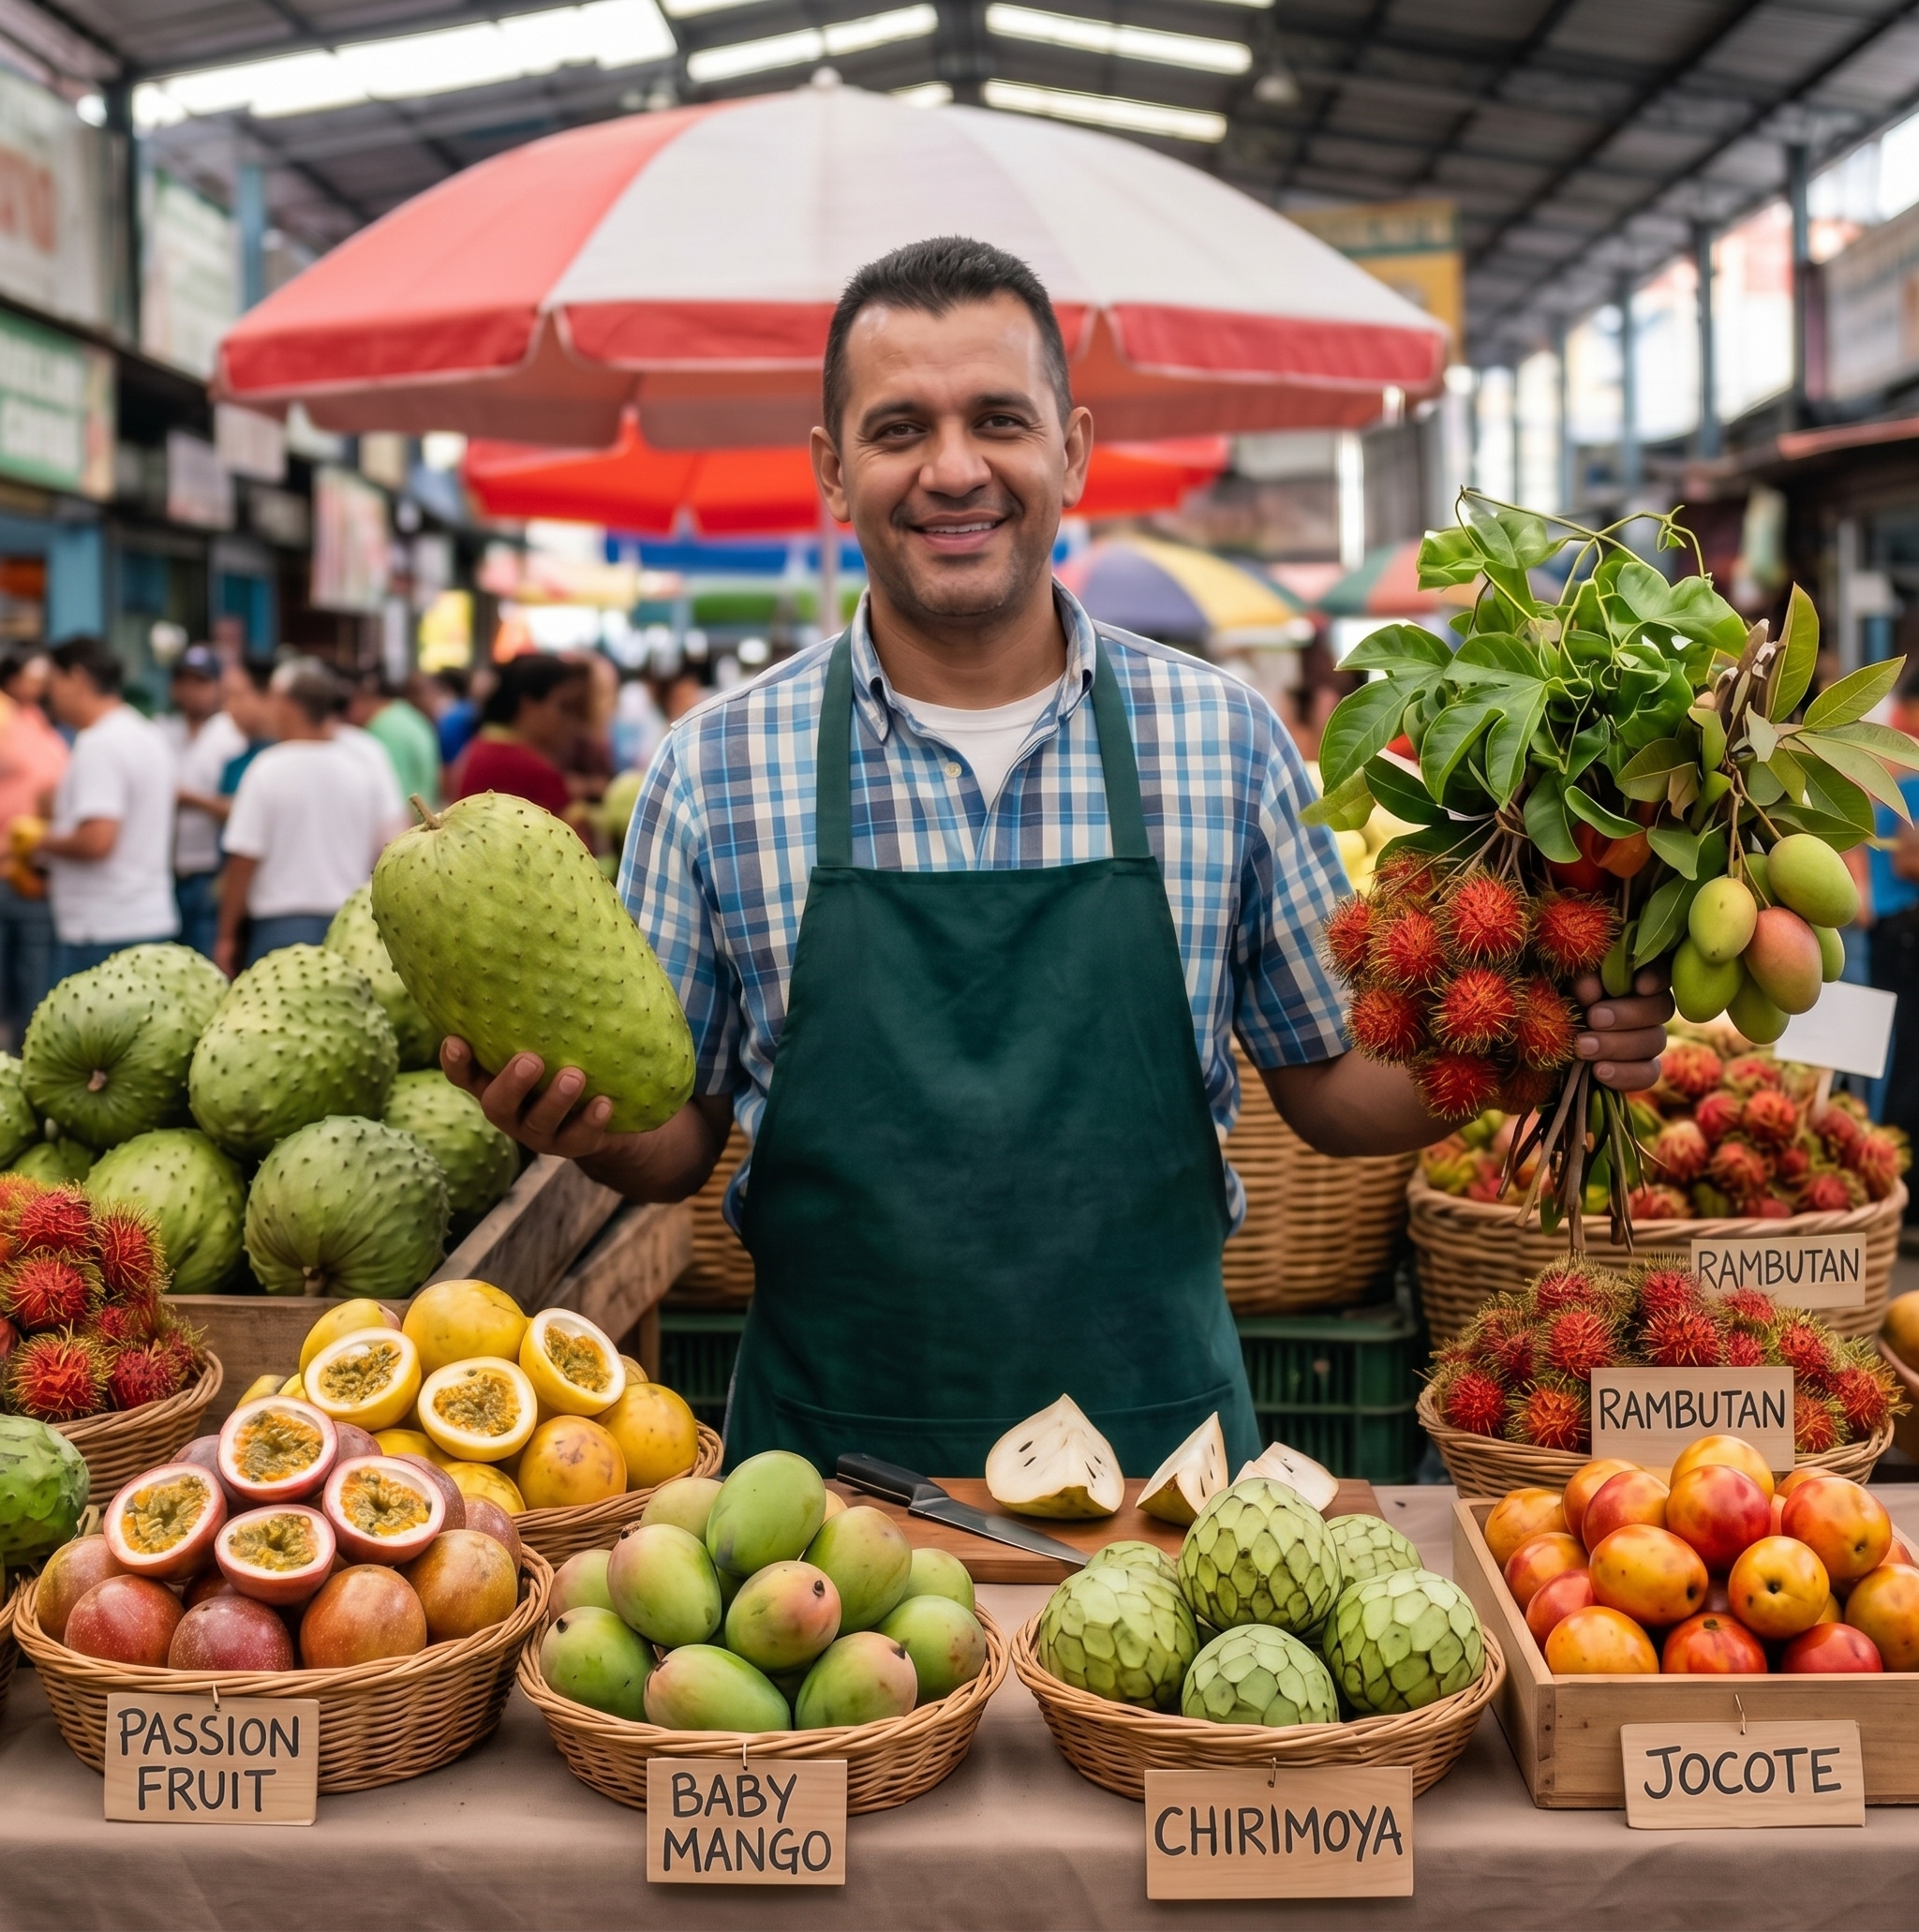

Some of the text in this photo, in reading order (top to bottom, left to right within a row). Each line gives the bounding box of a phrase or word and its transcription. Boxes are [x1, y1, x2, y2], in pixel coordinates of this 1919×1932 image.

[1698, 1248, 1859, 1290] RAMBUTAN
[1599, 1389, 1786, 1431] RAMBUTAN
[117, 1707, 300, 1758] PASSION
[138, 1765, 277, 1813] FRUIT
[671, 1771, 797, 1824] BABY
[1644, 1746, 1842, 1800] JOCOTE
[662, 1826, 832, 1876] MANGO
[1154, 1804, 1405, 1863] CHIRIMOYA
